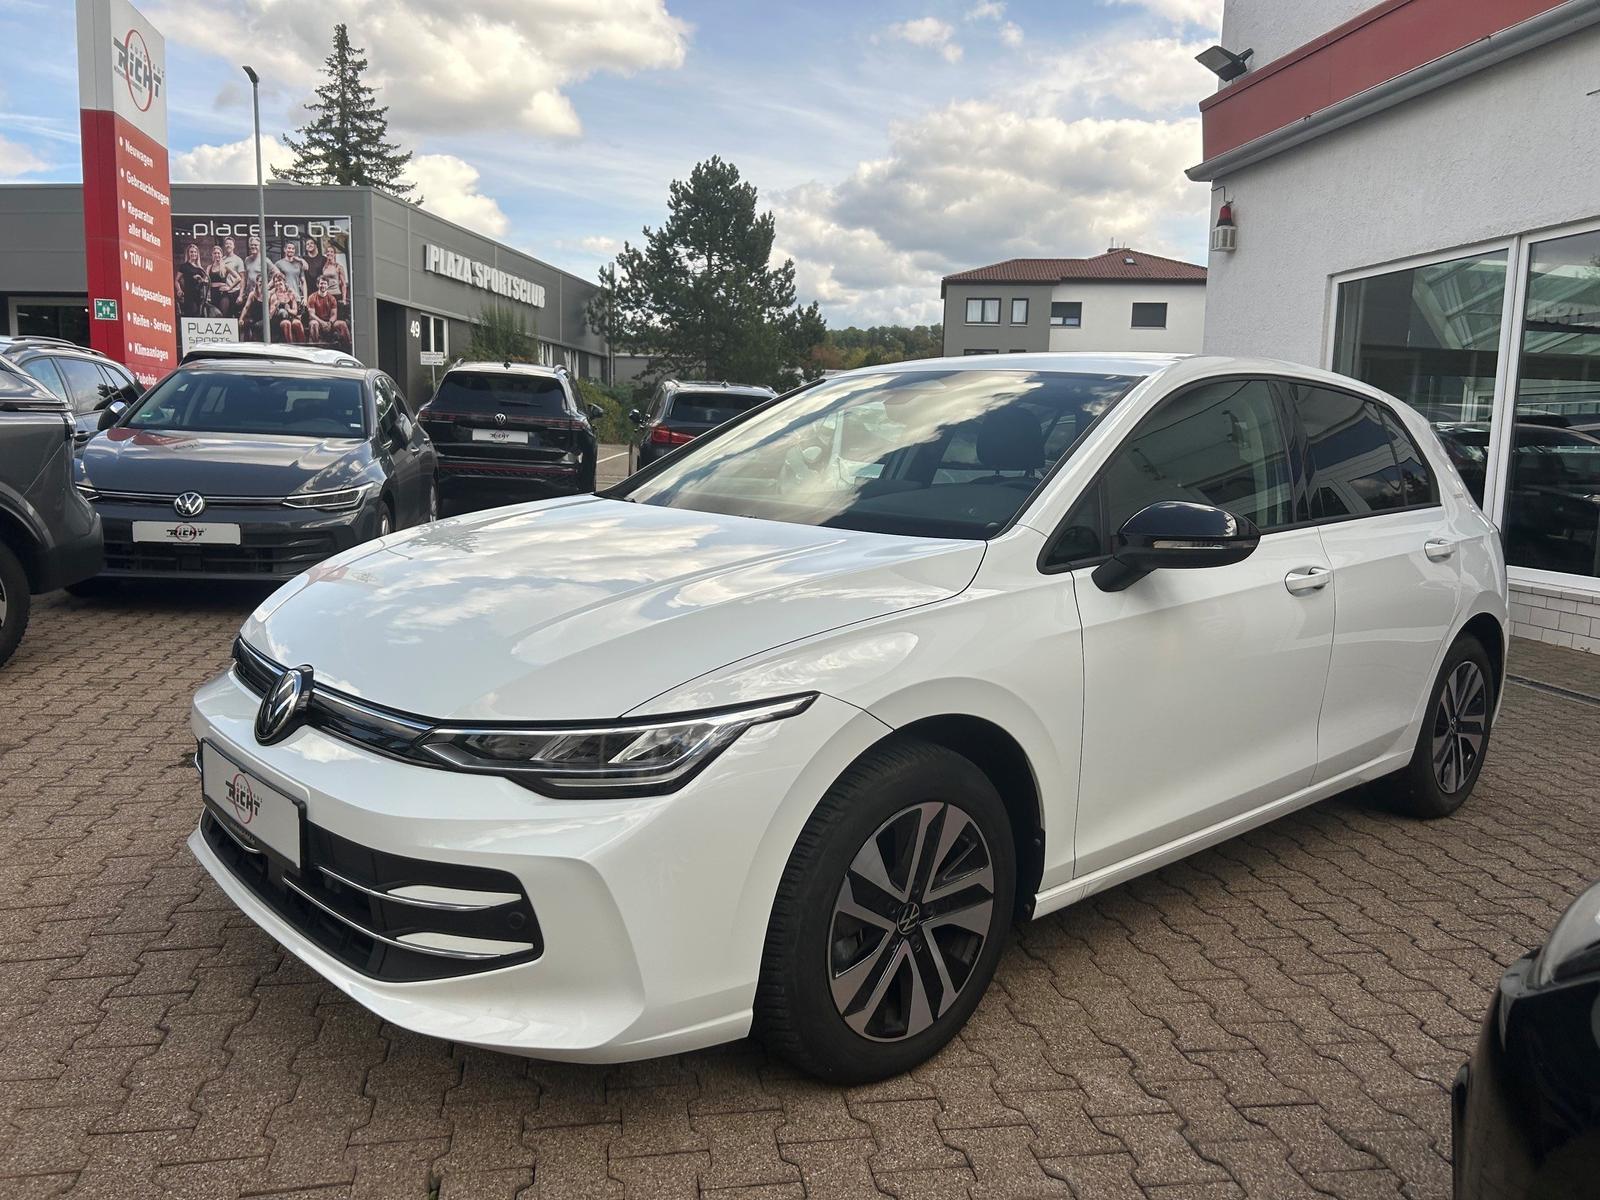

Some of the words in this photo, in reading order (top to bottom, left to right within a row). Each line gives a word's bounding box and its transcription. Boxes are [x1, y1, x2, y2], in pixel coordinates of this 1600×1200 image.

[125, 139, 154, 168] Neuwagen
[126, 170, 170, 206] Gebrauchtwagen
[127, 201, 154, 225] Reparatur
[128, 222, 141, 238] aller
[141, 227, 161, 247] Marken
[273, 221, 299, 237] to
[308, 221, 342, 238] be
[145, 258, 153, 272] AU
[426, 244, 473, 285] PLAZA
[473, 261, 546, 308] SPORTSCLUB
[131, 282, 172, 307] Autogasanlagen
[132, 312, 150, 329] Reifen
[153, 318, 172, 334] Service
[187, 322, 232, 335] PLAZA
[410, 320, 420, 338] 49
[134, 342, 169, 362] Klimaanlagen
